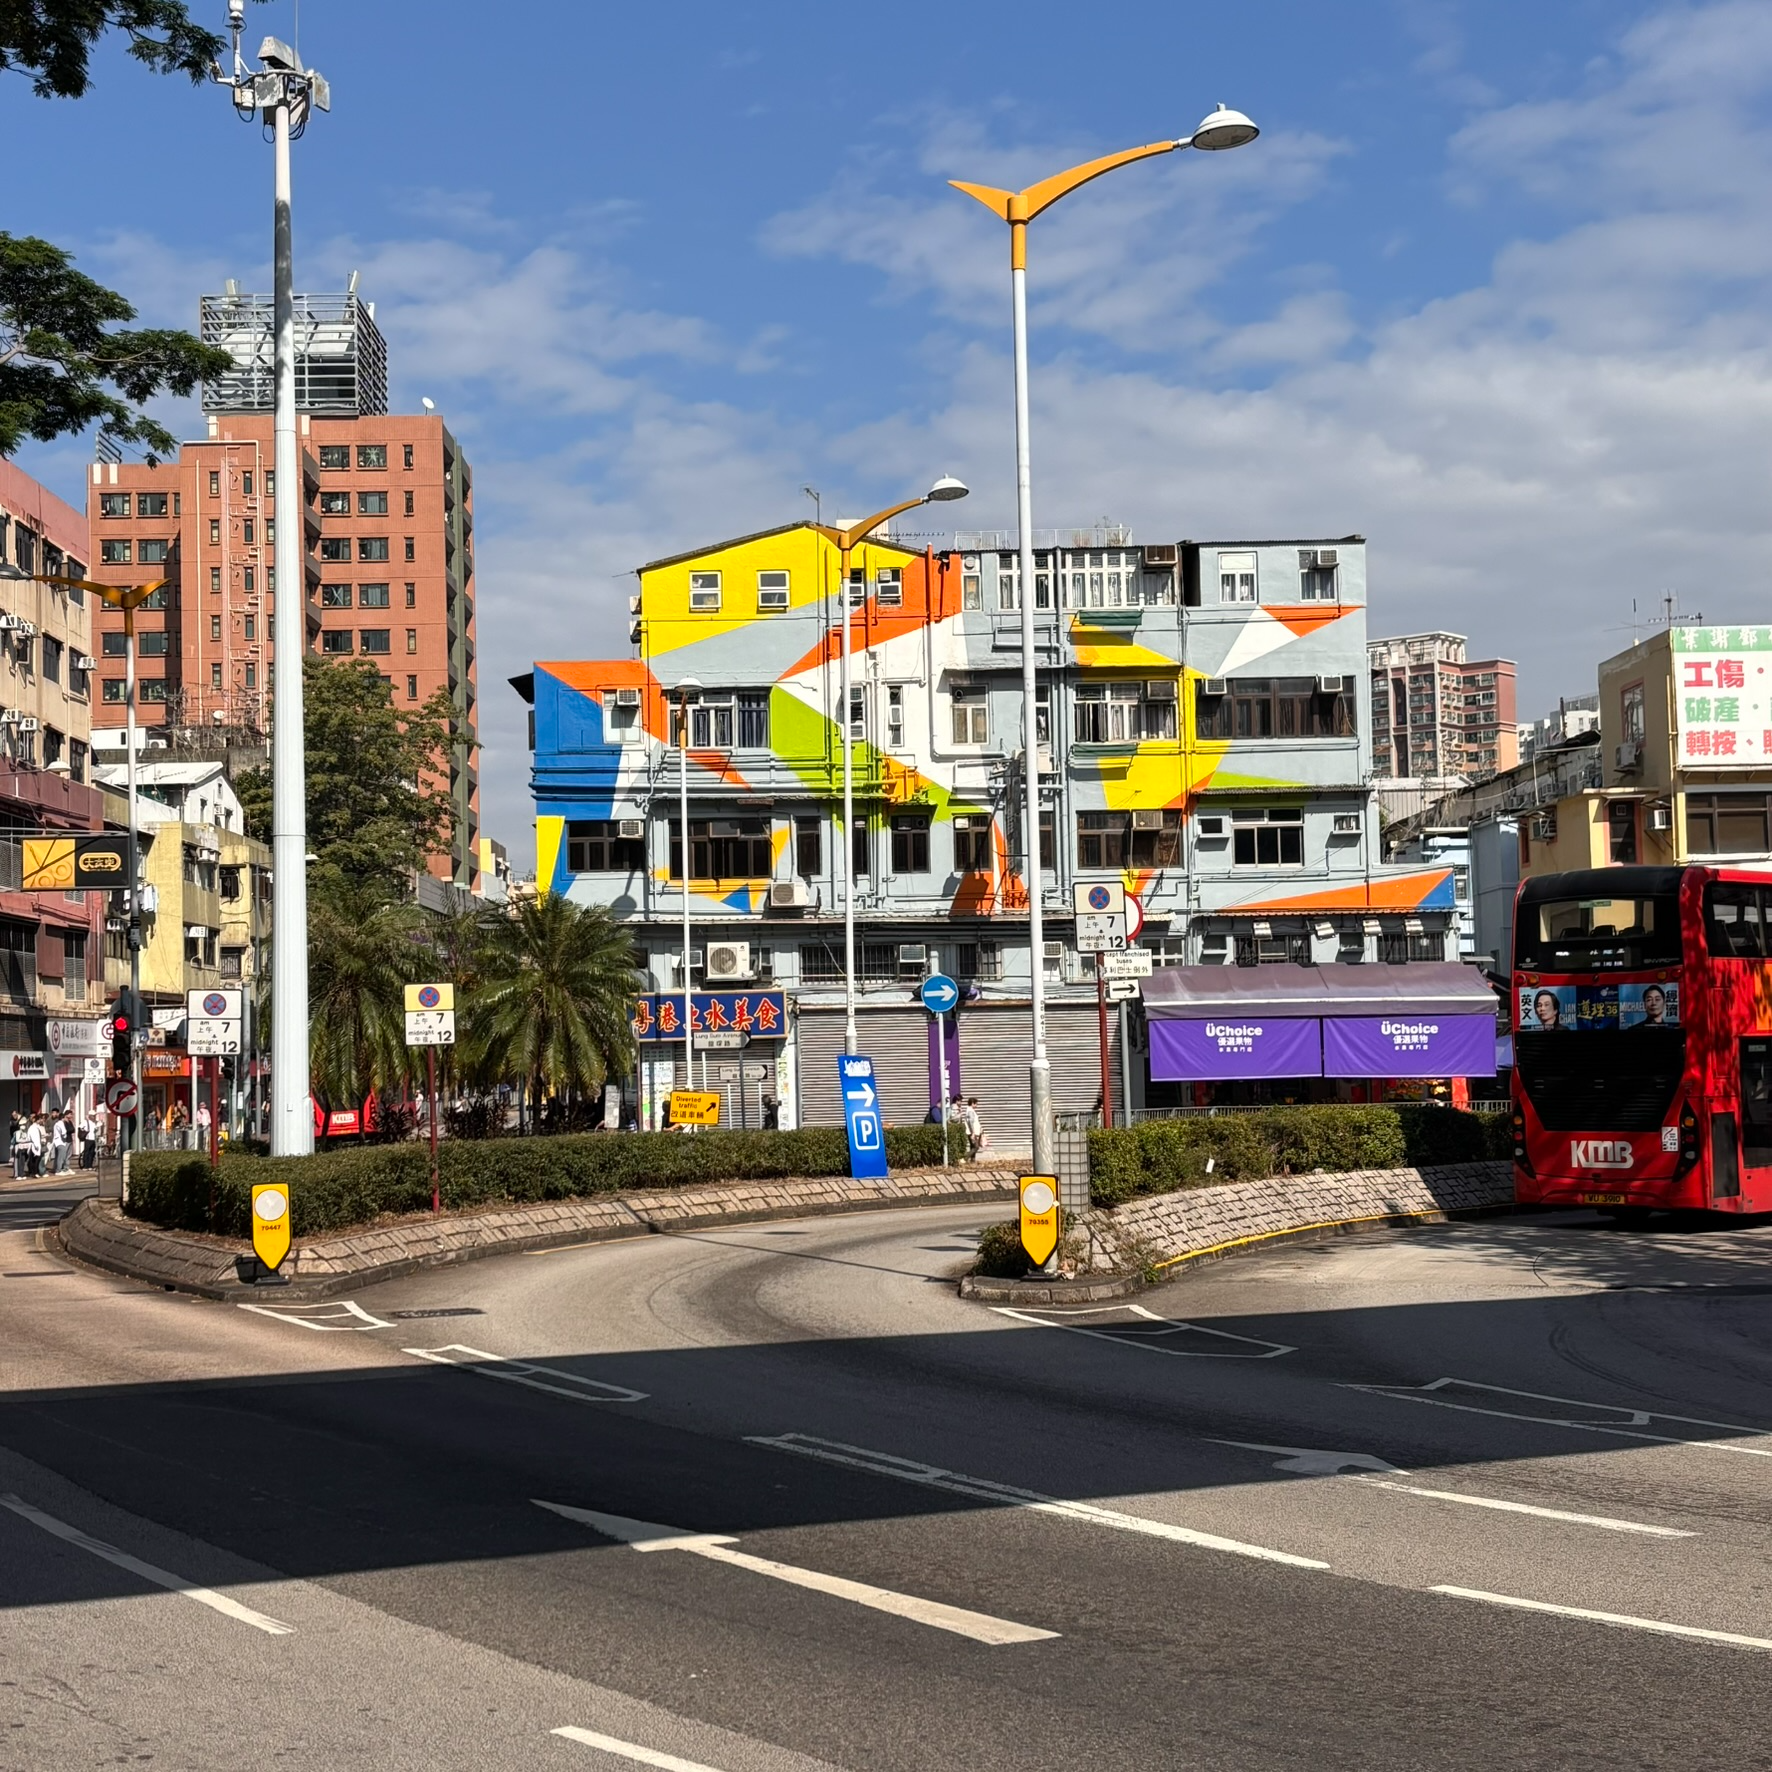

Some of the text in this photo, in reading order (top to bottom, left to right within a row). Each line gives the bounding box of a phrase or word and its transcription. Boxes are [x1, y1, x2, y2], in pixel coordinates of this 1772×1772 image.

[1106, 915, 1115, 928] 7
[1108, 935, 1124, 948] 12
[1521, 994, 1533, 1020] 英文
[1577, 999, 1605, 1020] 遵理
[1607, 1005, 1618, 1015] 36
[436, 1012, 445, 1024] 7
[221, 1021, 231, 1034] 7
[1205, 1022, 1263, 1037] ÜChoice
[1381, 1020, 1439, 1035] ÜChoice
[437, 1030, 452, 1042] 12
[221, 1040, 238, 1053] 12
[332, 1113, 355, 1124] KMB
[860, 1119, 873, 1143] P
[1570, 1140, 1634, 1168] KMB
